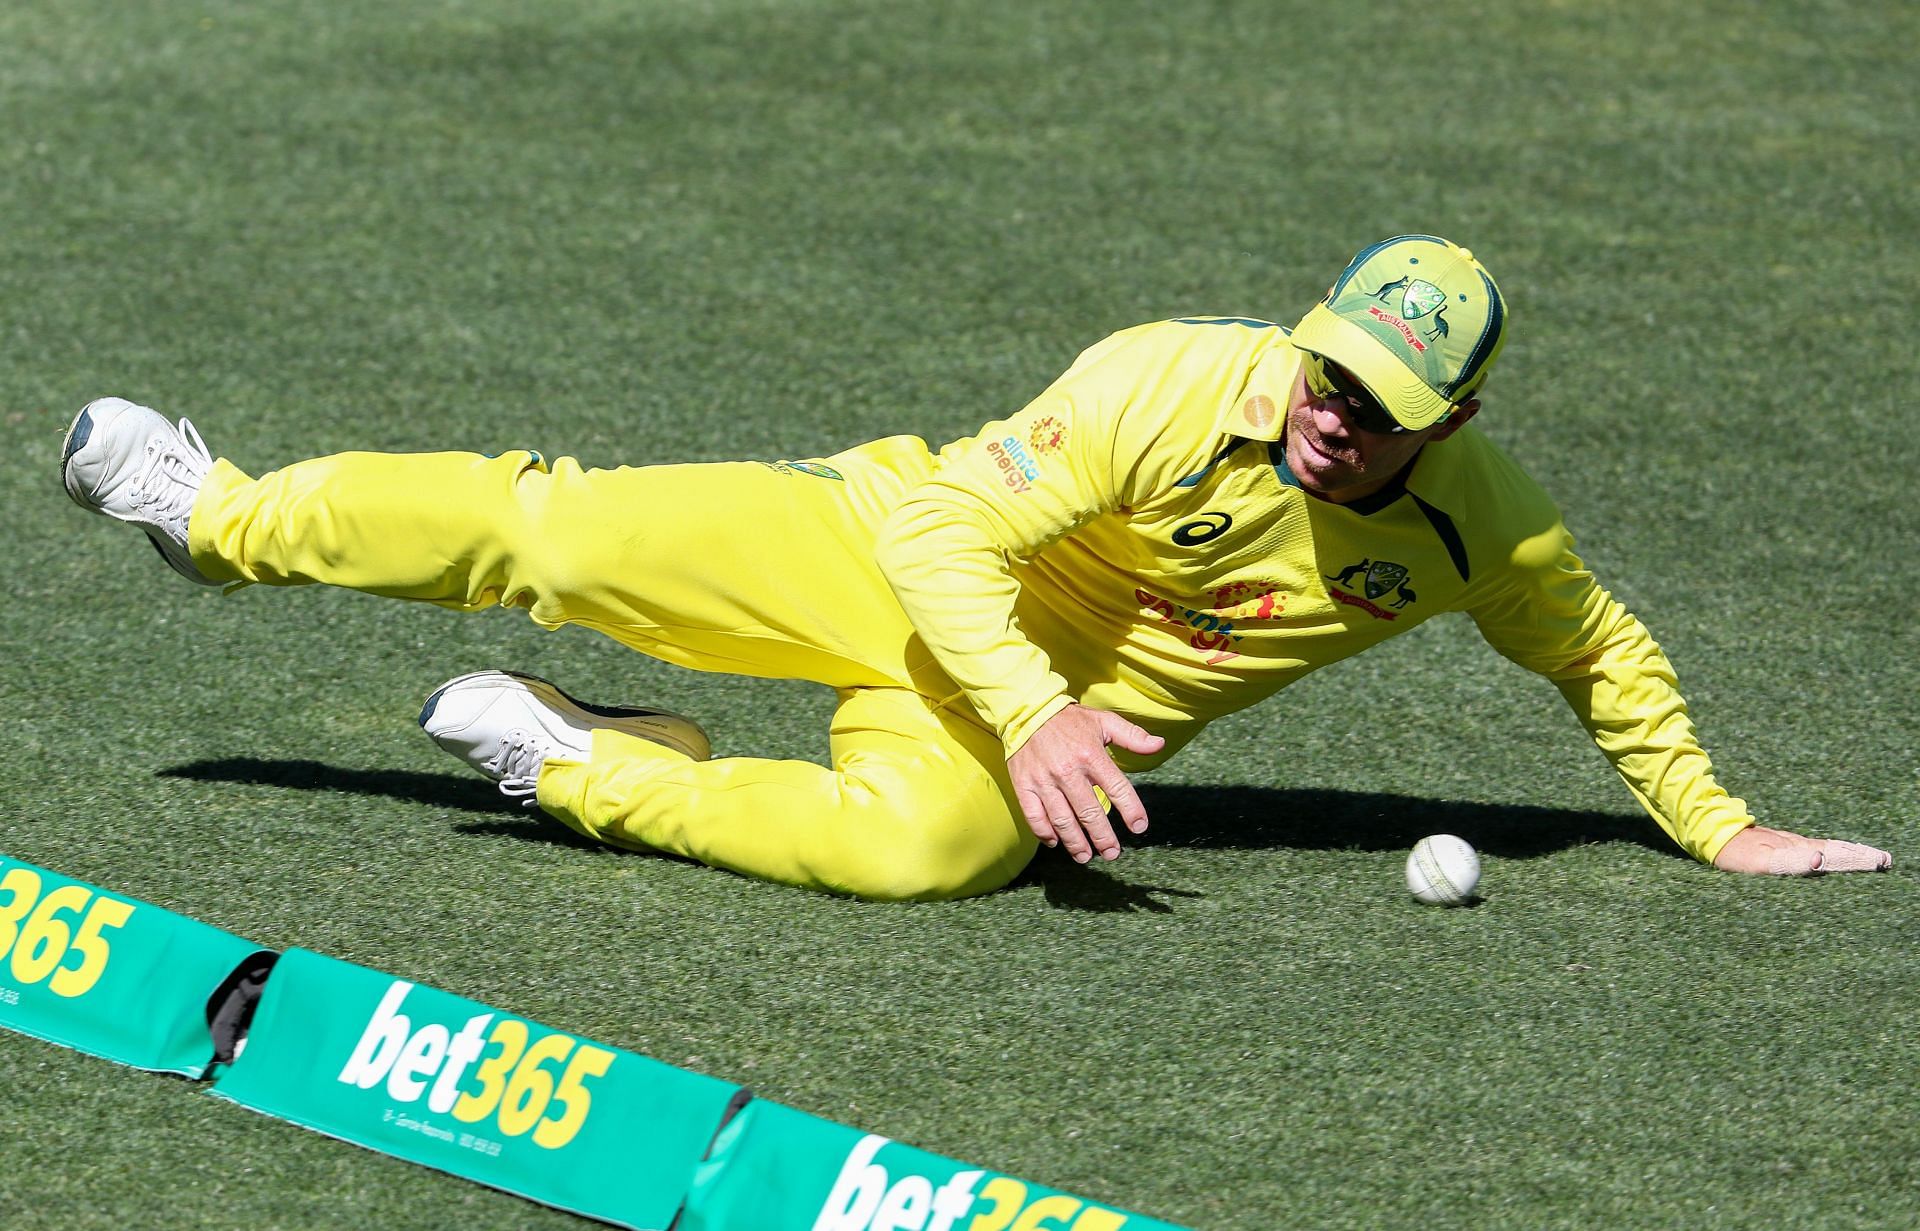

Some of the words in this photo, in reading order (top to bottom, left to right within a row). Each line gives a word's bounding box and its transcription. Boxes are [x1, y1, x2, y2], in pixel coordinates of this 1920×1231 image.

[1380, 313, 1415, 343] AUSTRALIA
[986, 442, 1032, 495] energy
[1003, 436, 1040, 482] alinta
[337, 979, 618, 1150] bet365
